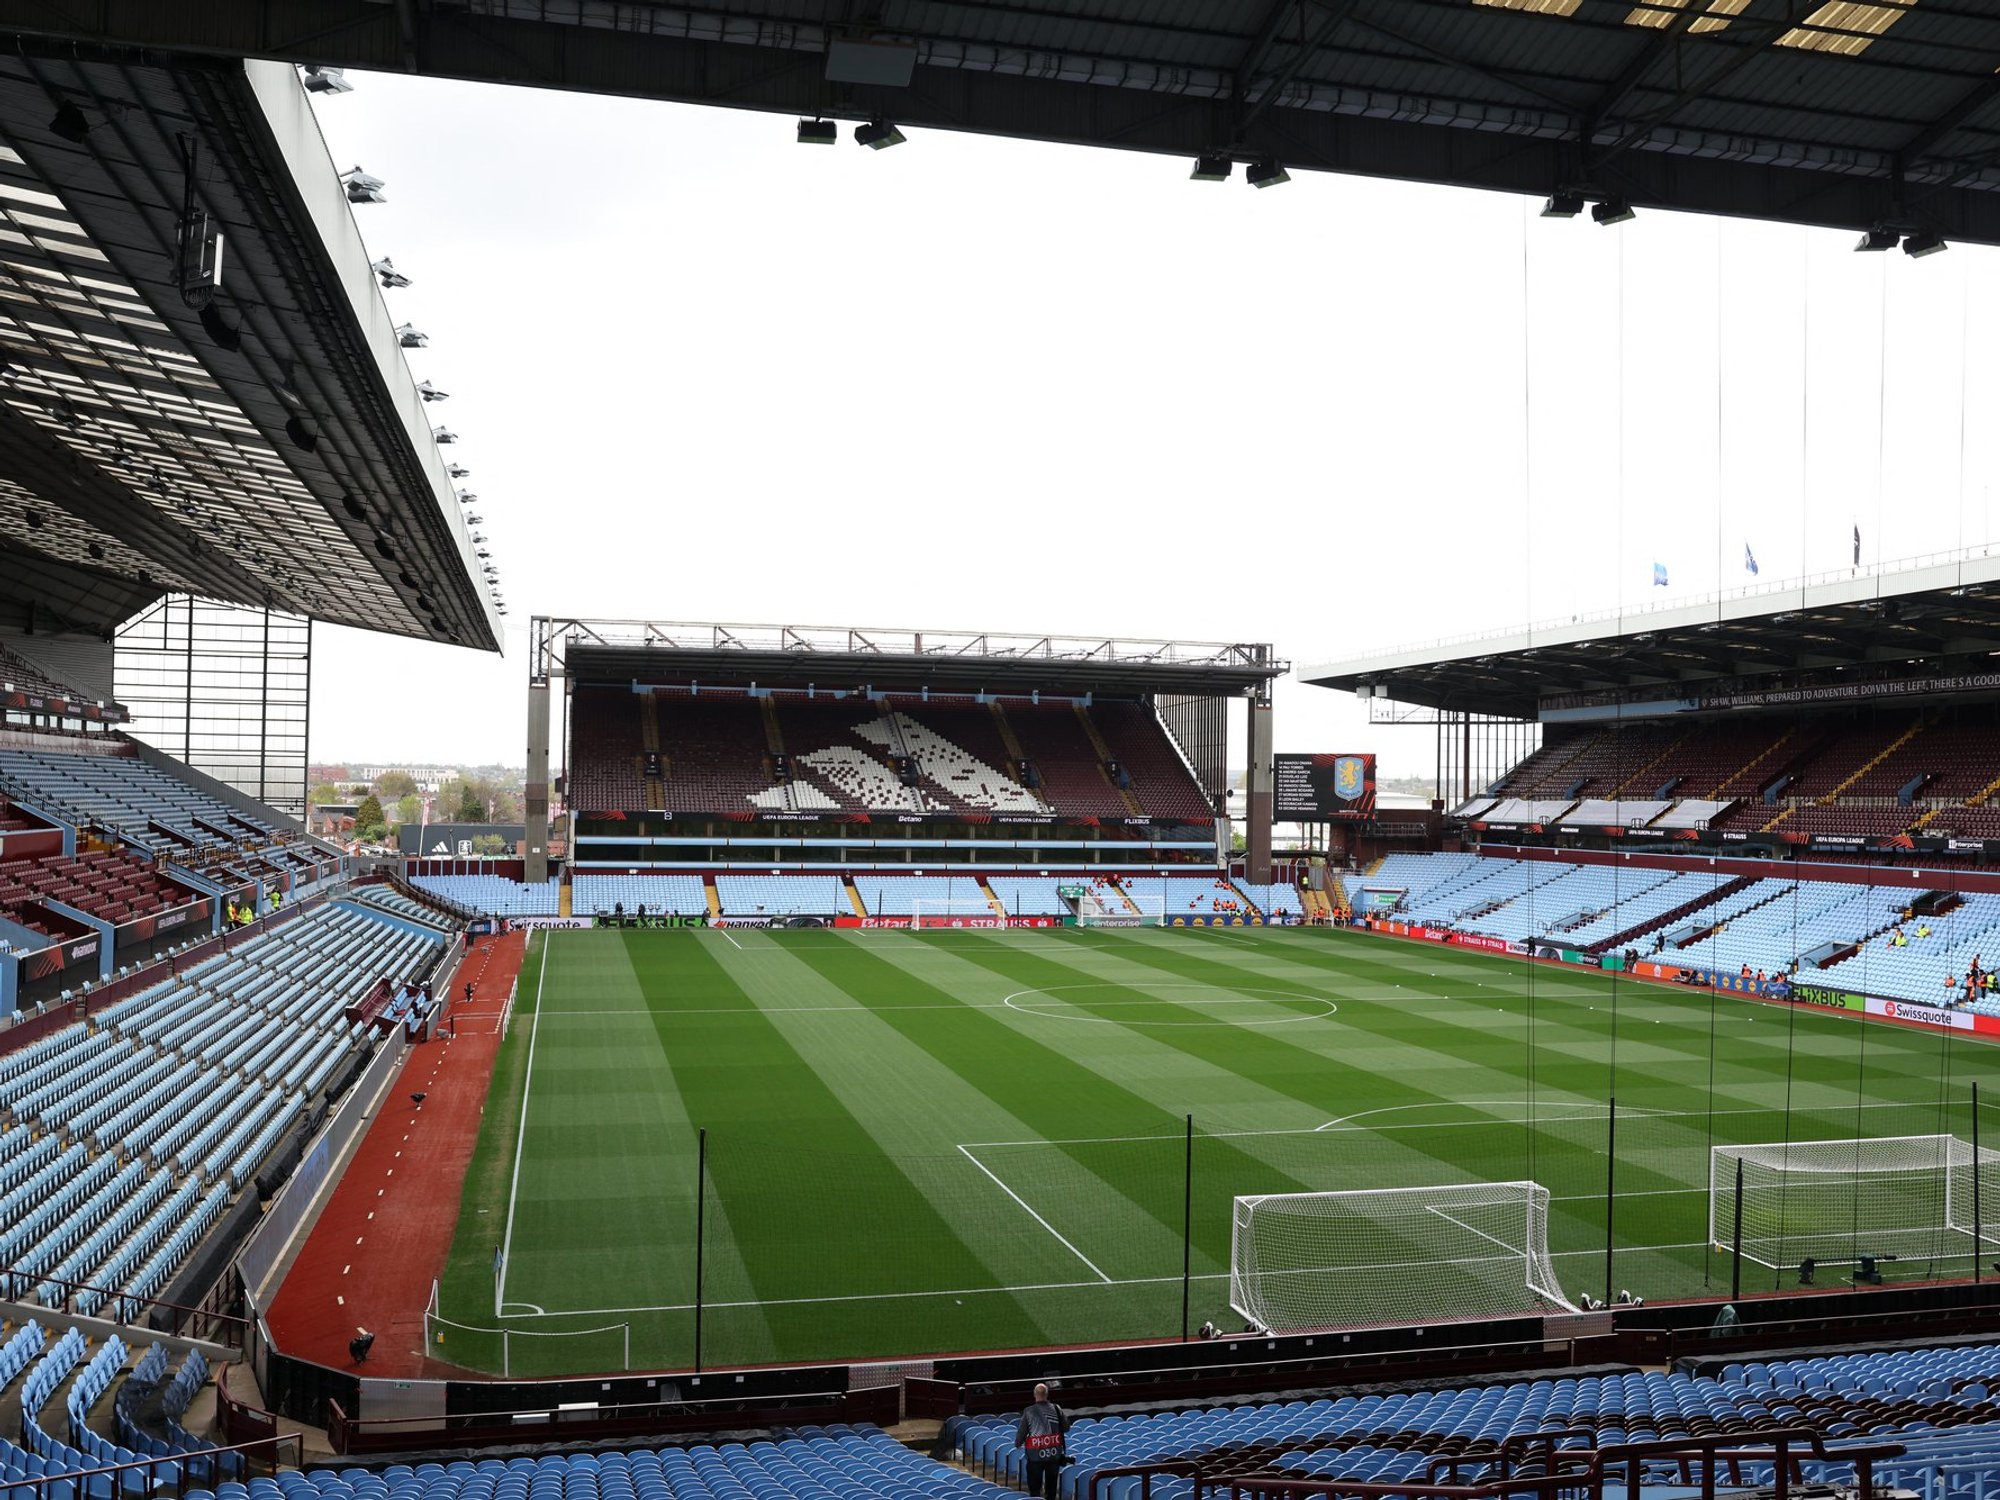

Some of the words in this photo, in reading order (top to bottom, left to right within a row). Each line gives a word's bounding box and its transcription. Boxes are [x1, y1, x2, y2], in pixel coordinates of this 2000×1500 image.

[1731, 693, 1765, 705] WILLIAMS,
[1766, 690, 1800, 702] PREPARED
[1803, 690, 1812, 700] TO
[1813, 684, 1858, 698] ADVENTURE
[1861, 683, 1888, 695] DOWN
[1890, 682, 1904, 692] THE
[1930, 676, 1964, 689] THERE'S
[1965, 677, 1972, 687] A
[1974, 674, 2000, 686] GOOD
[1896, 1004, 1952, 1025] Swissquote
[1039, 1447, 1057, 1458] 030
